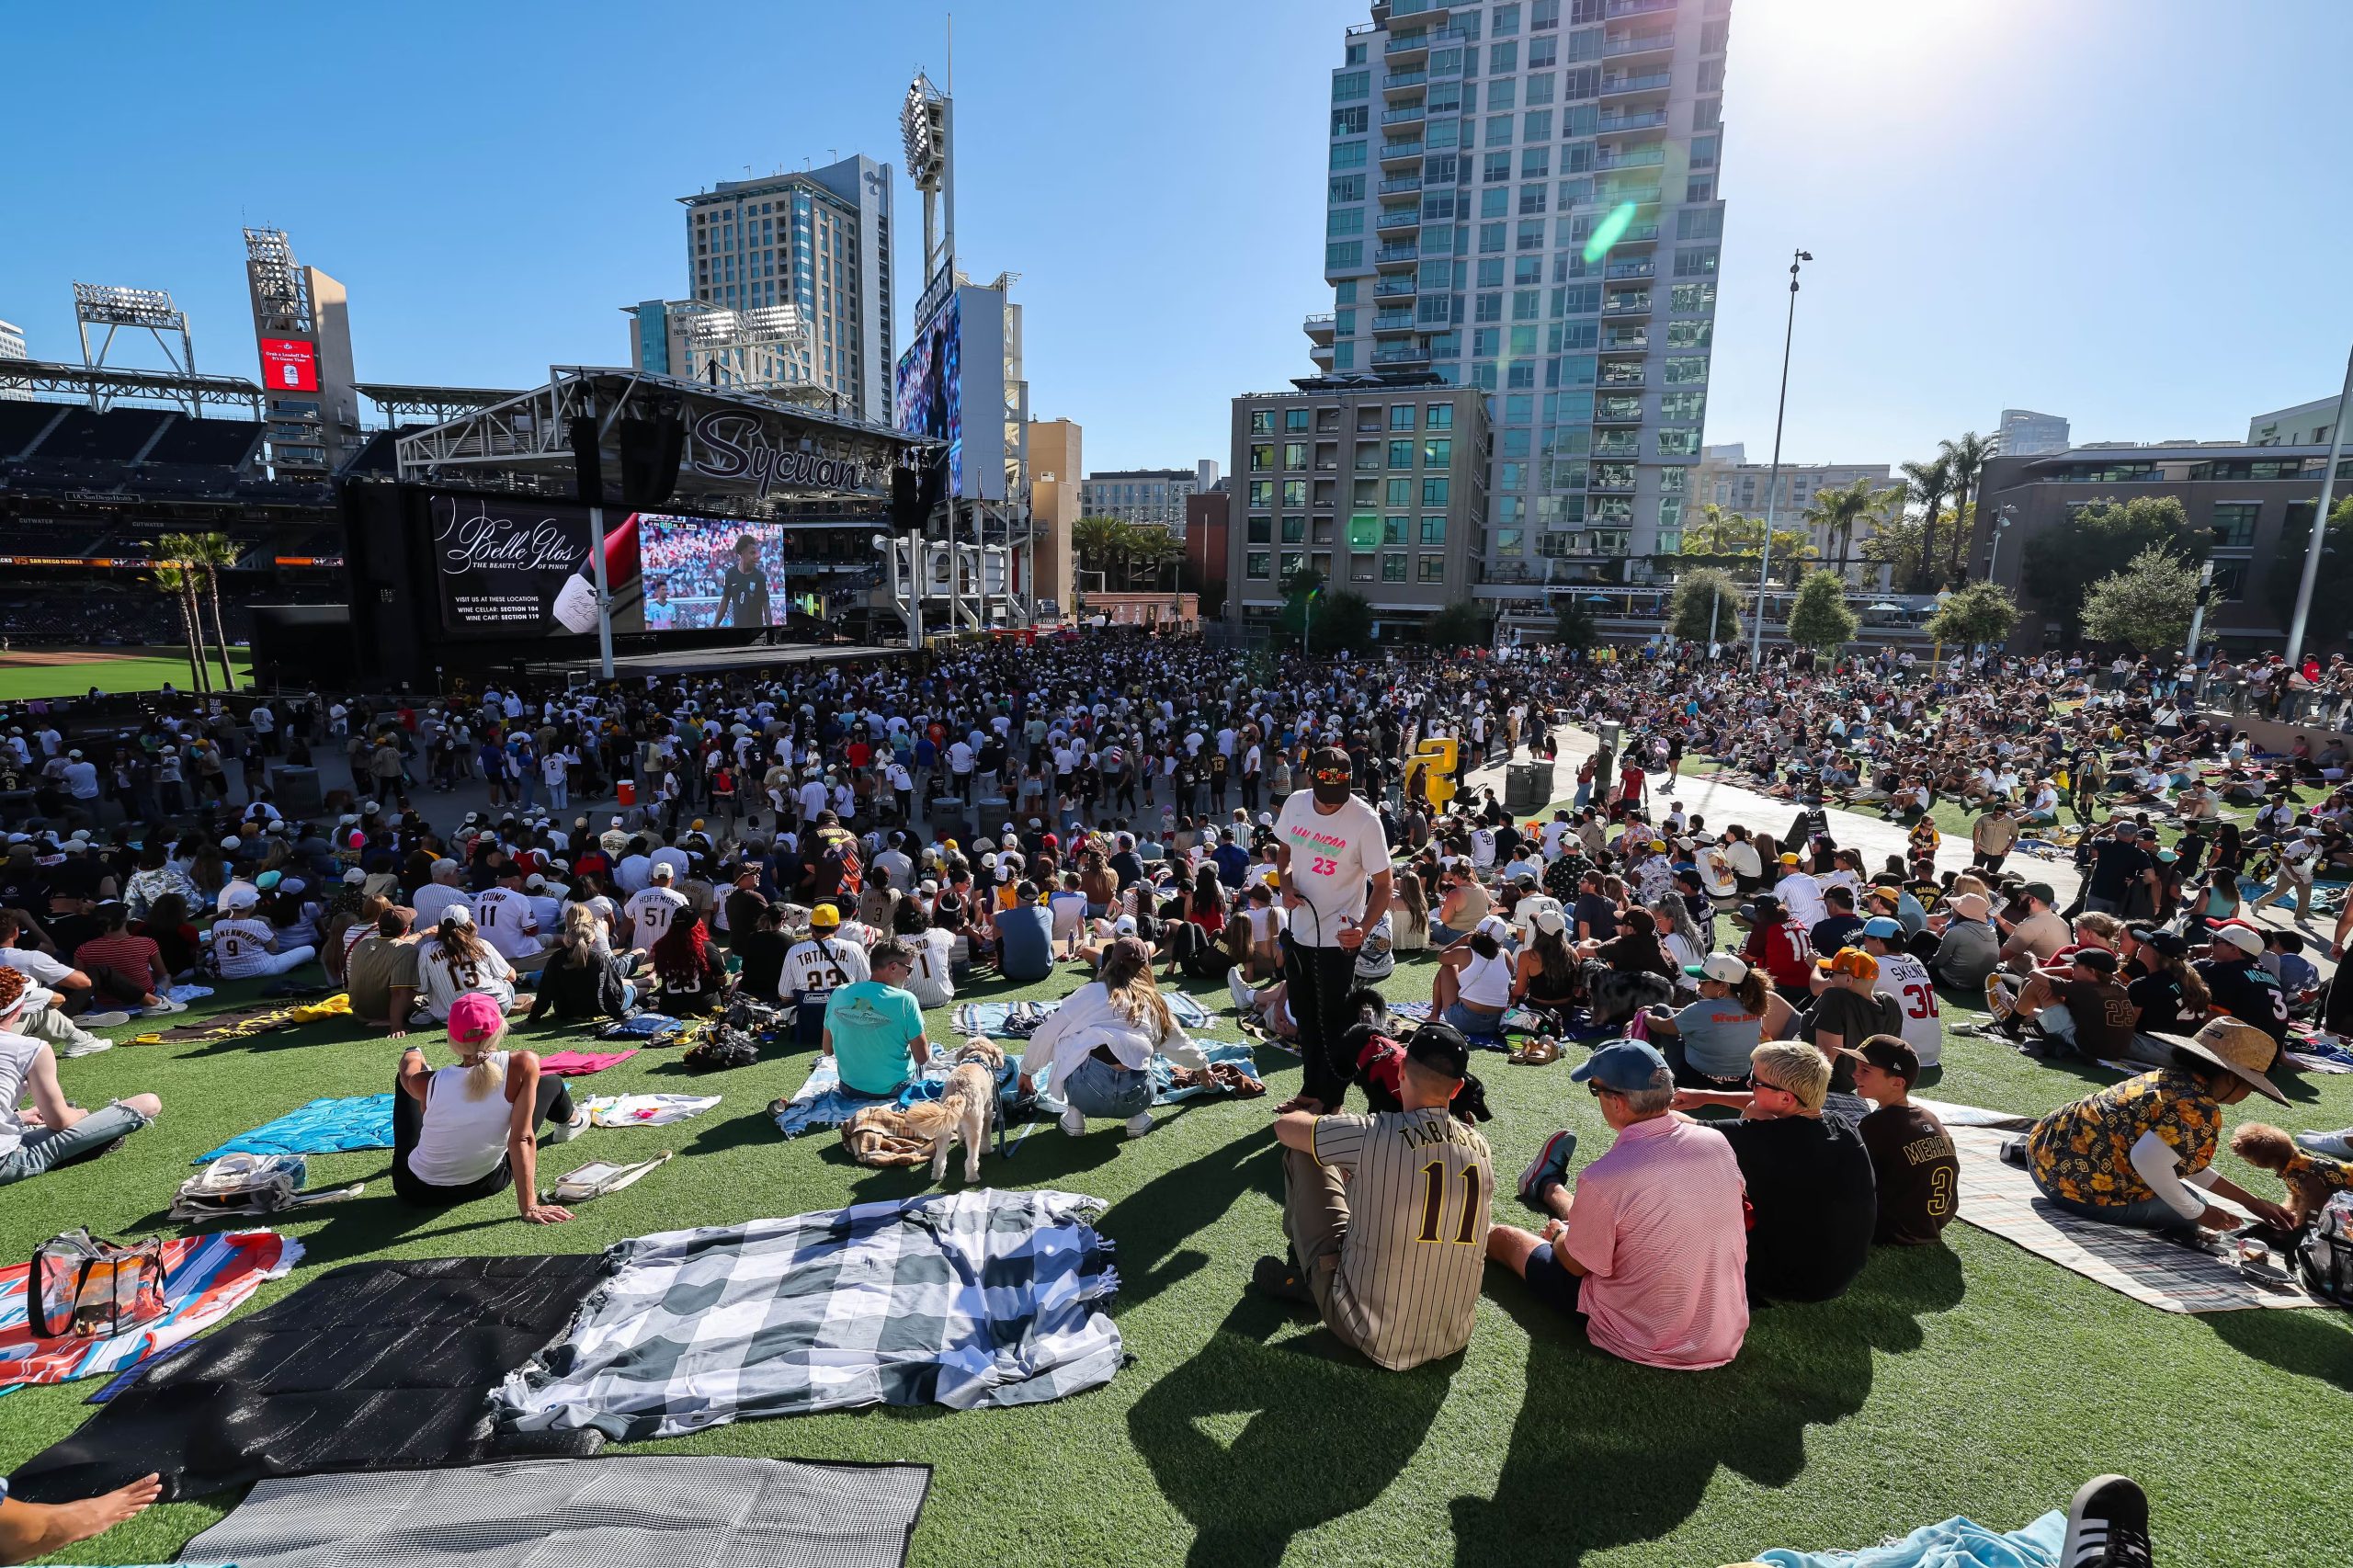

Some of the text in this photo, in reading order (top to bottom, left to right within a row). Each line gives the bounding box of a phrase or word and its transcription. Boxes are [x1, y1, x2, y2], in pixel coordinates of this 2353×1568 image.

[932, 266, 951, 315] park
[695, 409, 862, 500] Sycuan
[518, 518, 585, 570] Glos
[739, 591, 745, 604] 8
[209, 698, 222, 706] SEAT
[754, 752, 761, 761] 3
[550, 761, 556, 770] 2
[896, 765, 907, 775] 23
[1214, 761, 1224, 771] 13
[6, 777, 16, 790] 3
[1480, 831, 1494, 846] SD
[1312, 857, 1338, 876] 23
[482, 892, 507, 902] STUMP
[638, 895, 677, 906] HOFFMAN
[480, 905, 497, 927] 11
[645, 907, 667, 927] 51
[874, 907, 883, 922] 3
[226, 940, 238, 956] 9
[1784, 929, 1811, 962] 10
[834, 950, 848, 963] JR.
[920, 953, 930, 978] 1
[1890, 965, 1929, 981] SKENE
[447, 961, 480, 991] 13
[1903, 983, 1939, 1019] 30
[2267, 989, 2288, 1020] 3
[2104, 1000, 2134, 1027] 23
[1398, 1121, 1487, 1158] TABASCO
[2325, 1170, 2343, 1184] SD
[1927, 1166, 1953, 1216] 3
[1415, 1160, 1480, 1245] 11
